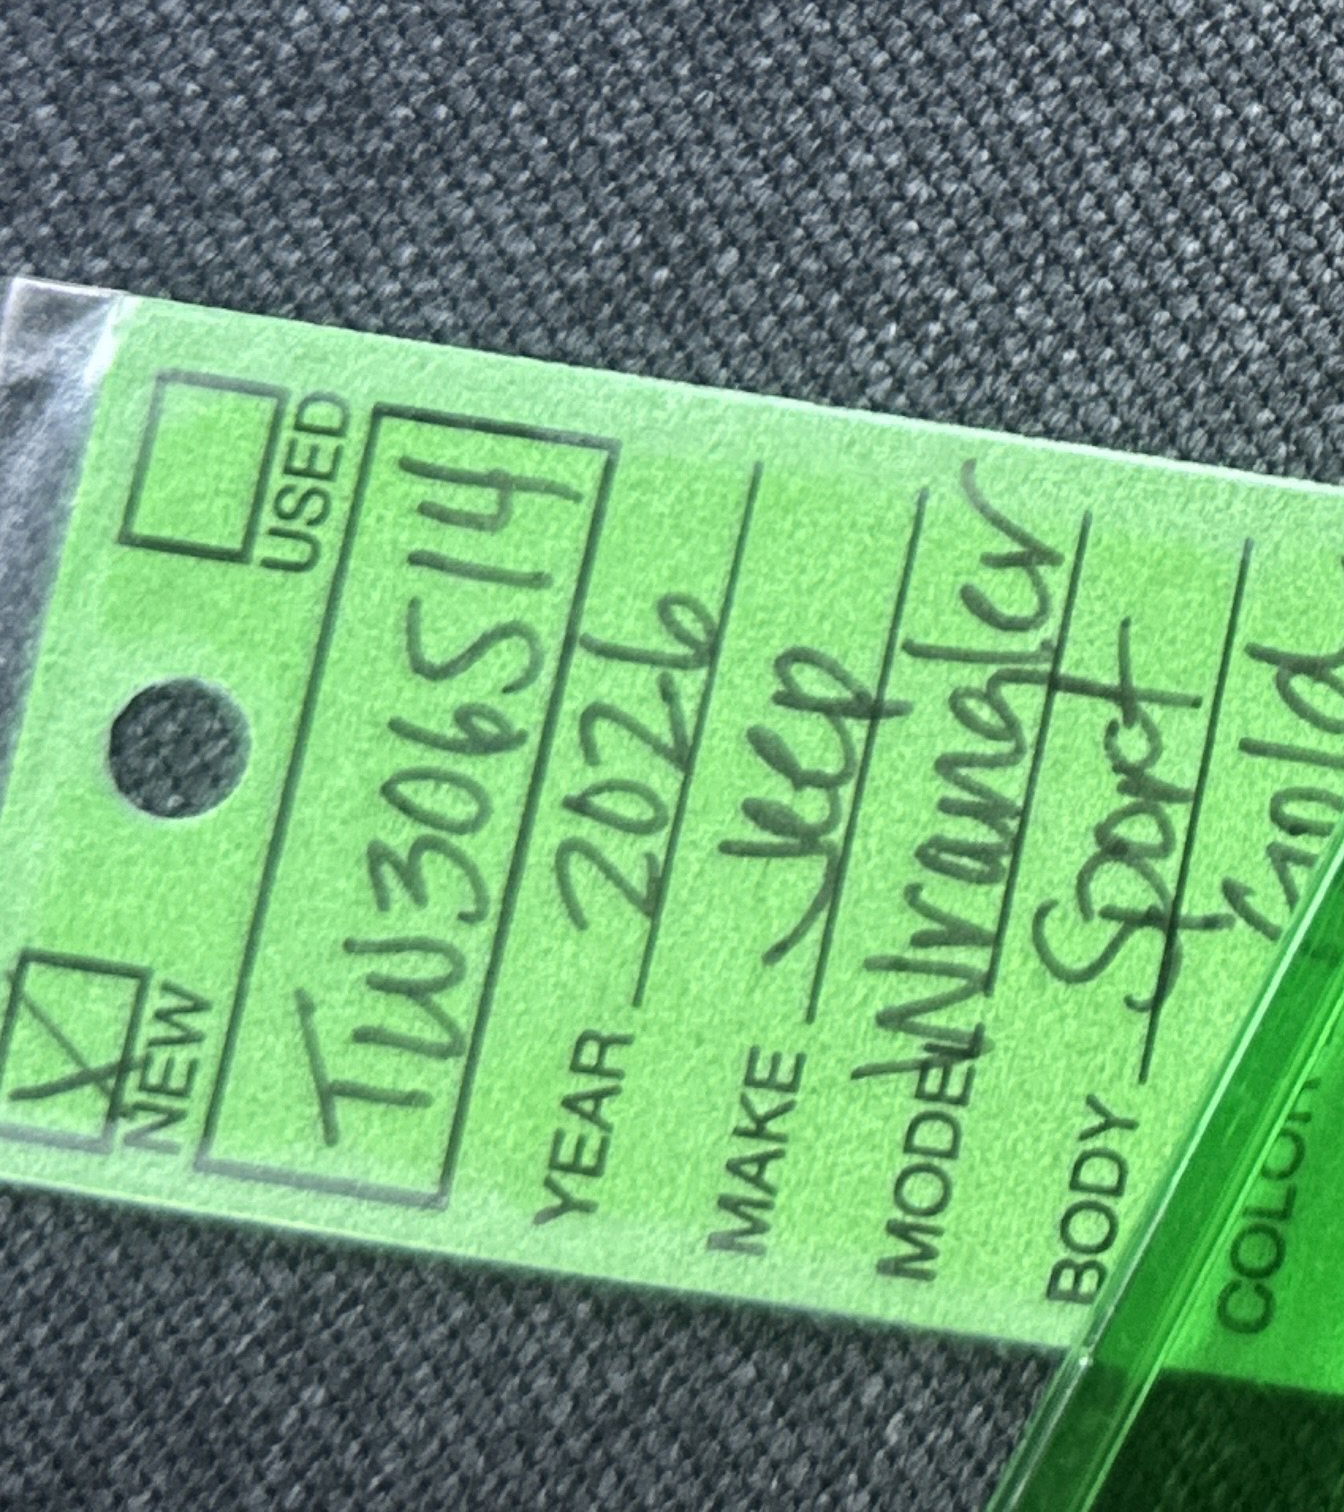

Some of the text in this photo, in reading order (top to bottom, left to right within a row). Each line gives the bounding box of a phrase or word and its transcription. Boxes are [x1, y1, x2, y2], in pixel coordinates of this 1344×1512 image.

[260, 389, 352, 574] USED
[553, 590, 722, 933] 2026
[718, 645, 915, 968] Jeep
[850, 458, 1075, 1080] Wrangler
[1032, 615, 1226, 1014] Sport
[122, 978, 213, 1156] NEW
[533, 1026, 636, 1225] YEAR
[708, 1044, 807, 1257] MAKE
[874, 1021, 986, 1283] MODEL
[1045, 1093, 1140, 1307] BODY
